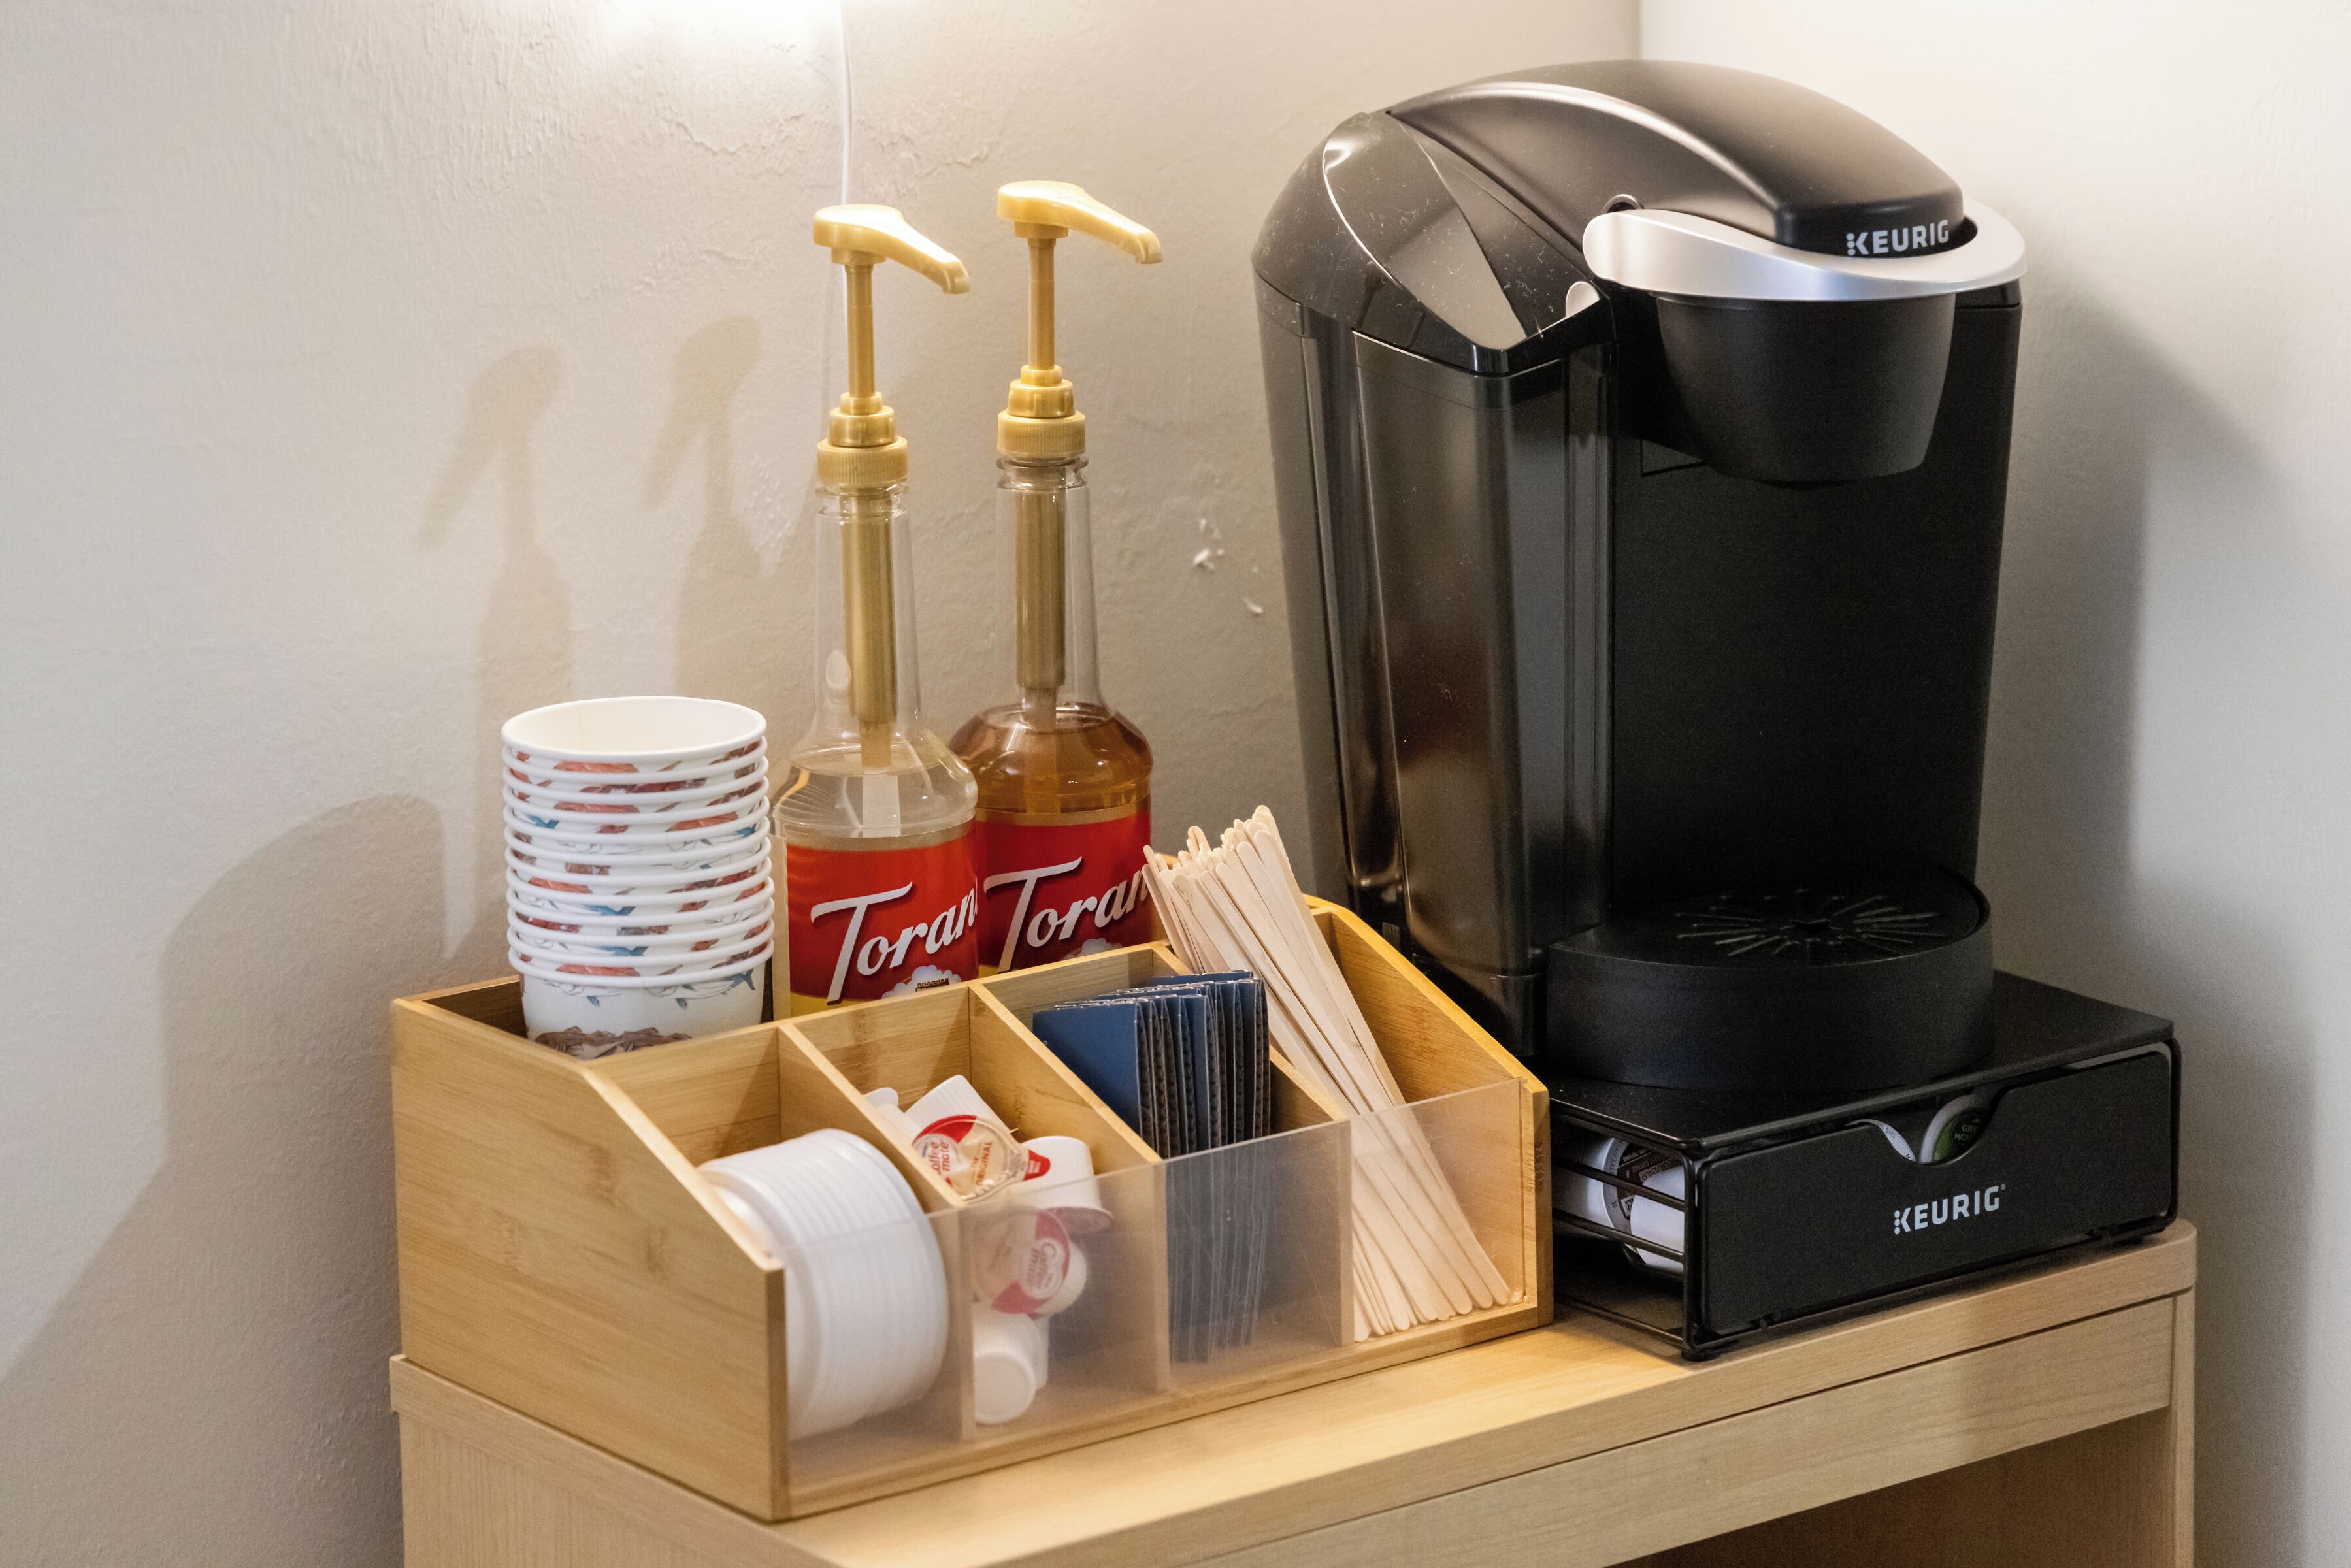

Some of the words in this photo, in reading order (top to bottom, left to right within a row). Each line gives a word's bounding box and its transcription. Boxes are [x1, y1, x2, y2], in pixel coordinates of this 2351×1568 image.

[1846, 220, 1949, 256] KEURIG
[811, 877, 978, 1005] Toran
[928, 1141, 941, 1175] offee
[1894, 1185, 1999, 1235] KEURIG
